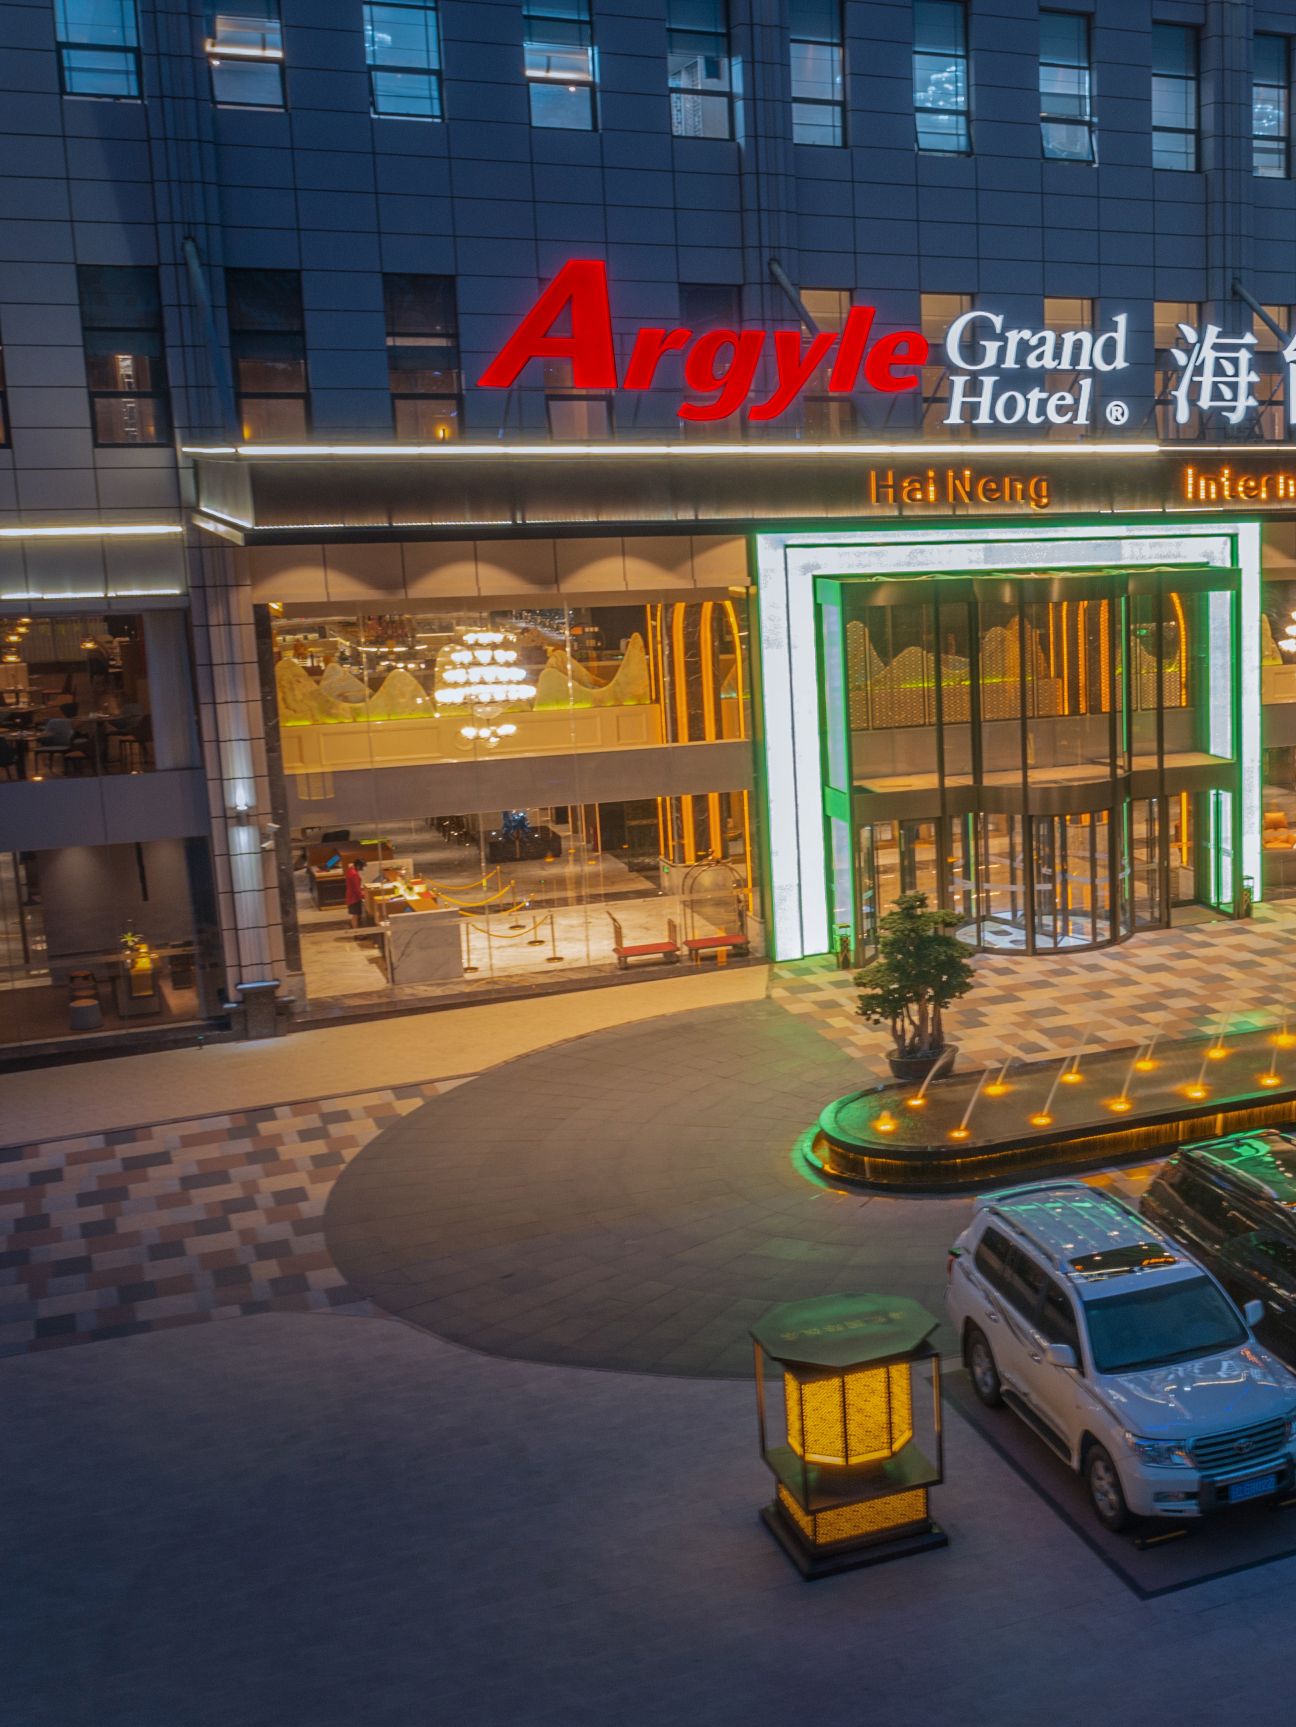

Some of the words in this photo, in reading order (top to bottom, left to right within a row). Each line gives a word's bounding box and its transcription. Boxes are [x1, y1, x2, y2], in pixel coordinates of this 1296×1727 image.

[476, 259, 930, 422] Argyle
[946, 311, 1129, 373] Grand
[943, 376, 1092, 425] Hotel
[869, 469, 936, 506] Hai
[947, 469, 1050, 511] Neng
